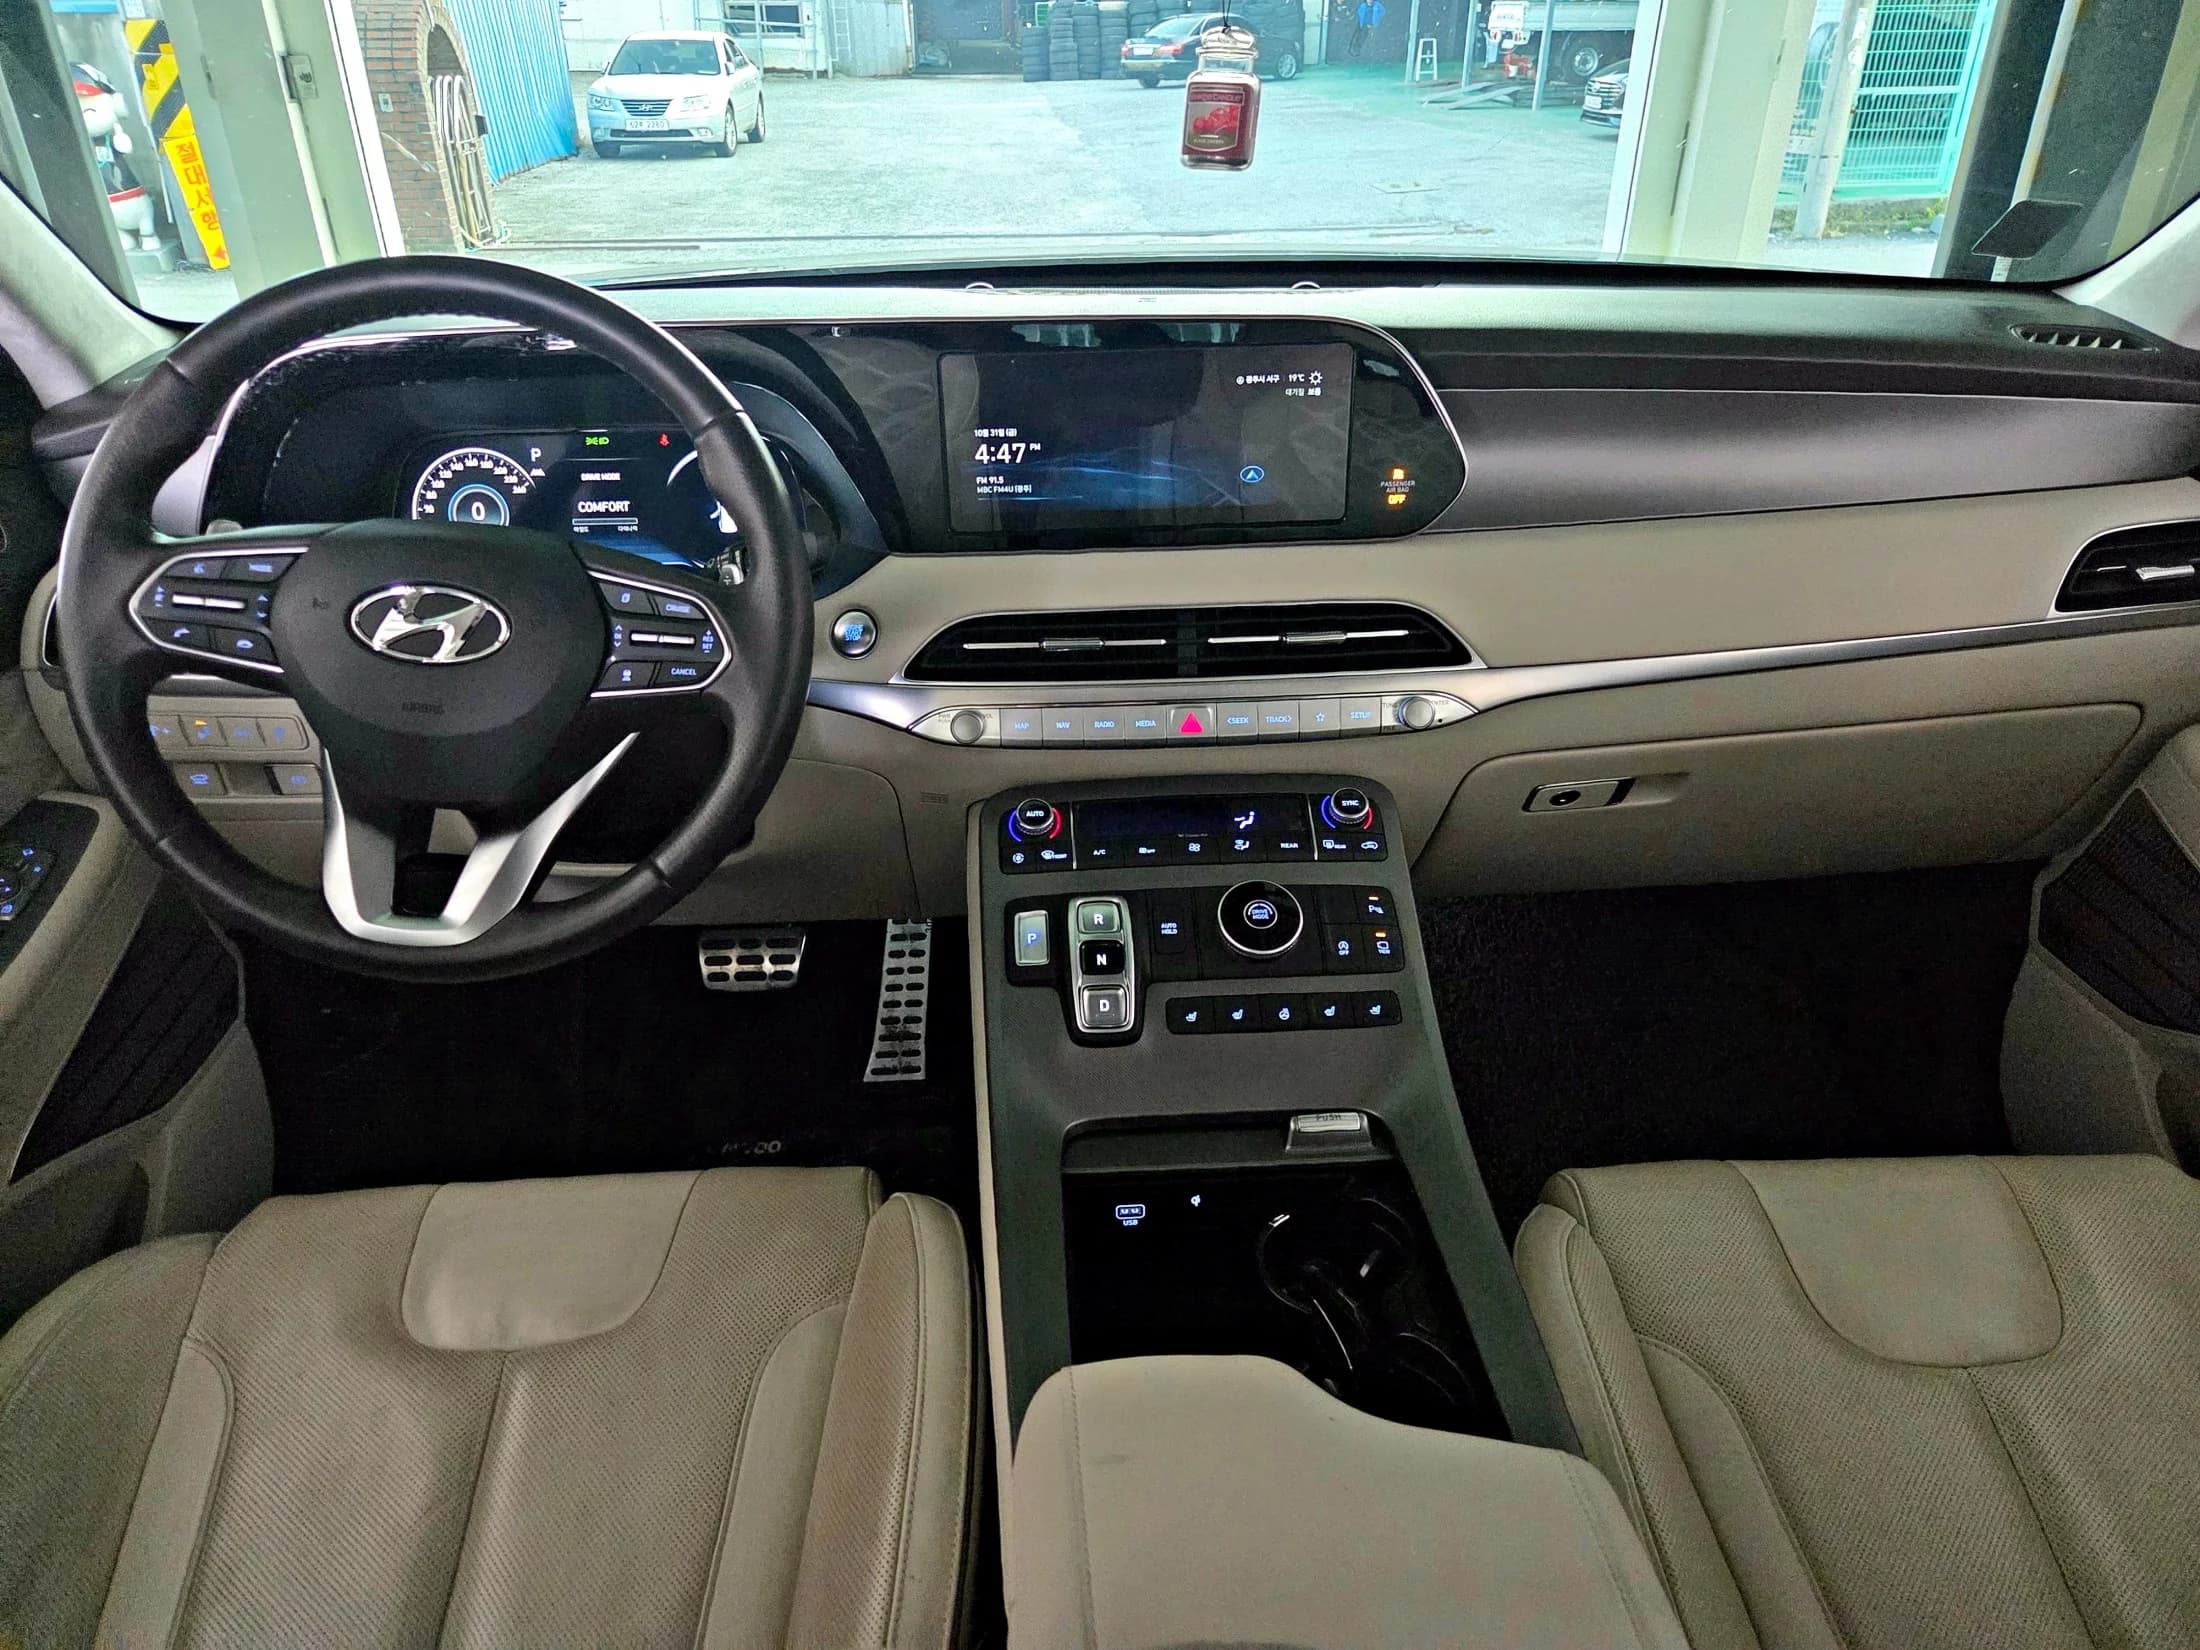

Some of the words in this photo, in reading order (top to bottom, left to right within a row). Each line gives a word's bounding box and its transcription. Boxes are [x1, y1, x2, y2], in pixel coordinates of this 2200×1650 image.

[530, 447, 541, 462] P
[974, 442, 1026, 464] 4:47
[1029, 442, 1041, 451] PM
[976, 476, 988, 484] FM
[988, 476, 1004, 484] 91.5
[977, 486, 992, 494] MBC
[1388, 494, 1406, 504] OFF
[471, 501, 486, 521] 0
[578, 501, 631, 512] COMFORT
[671, 667, 697, 676] CANCEL
[1350, 711, 1372, 720] SETUP
[1014, 721, 1030, 729] MAP
[1056, 721, 1071, 729] NAV
[1094, 720, 1116, 729] RADIO
[1135, 719, 1157, 728] MEDIA
[1026, 810, 1045, 818] AUTO
[1094, 914, 1104, 926] R
[1027, 933, 1037, 945] P
[1096, 954, 1107, 966] N
[1099, 1000, 1110, 1011] D
